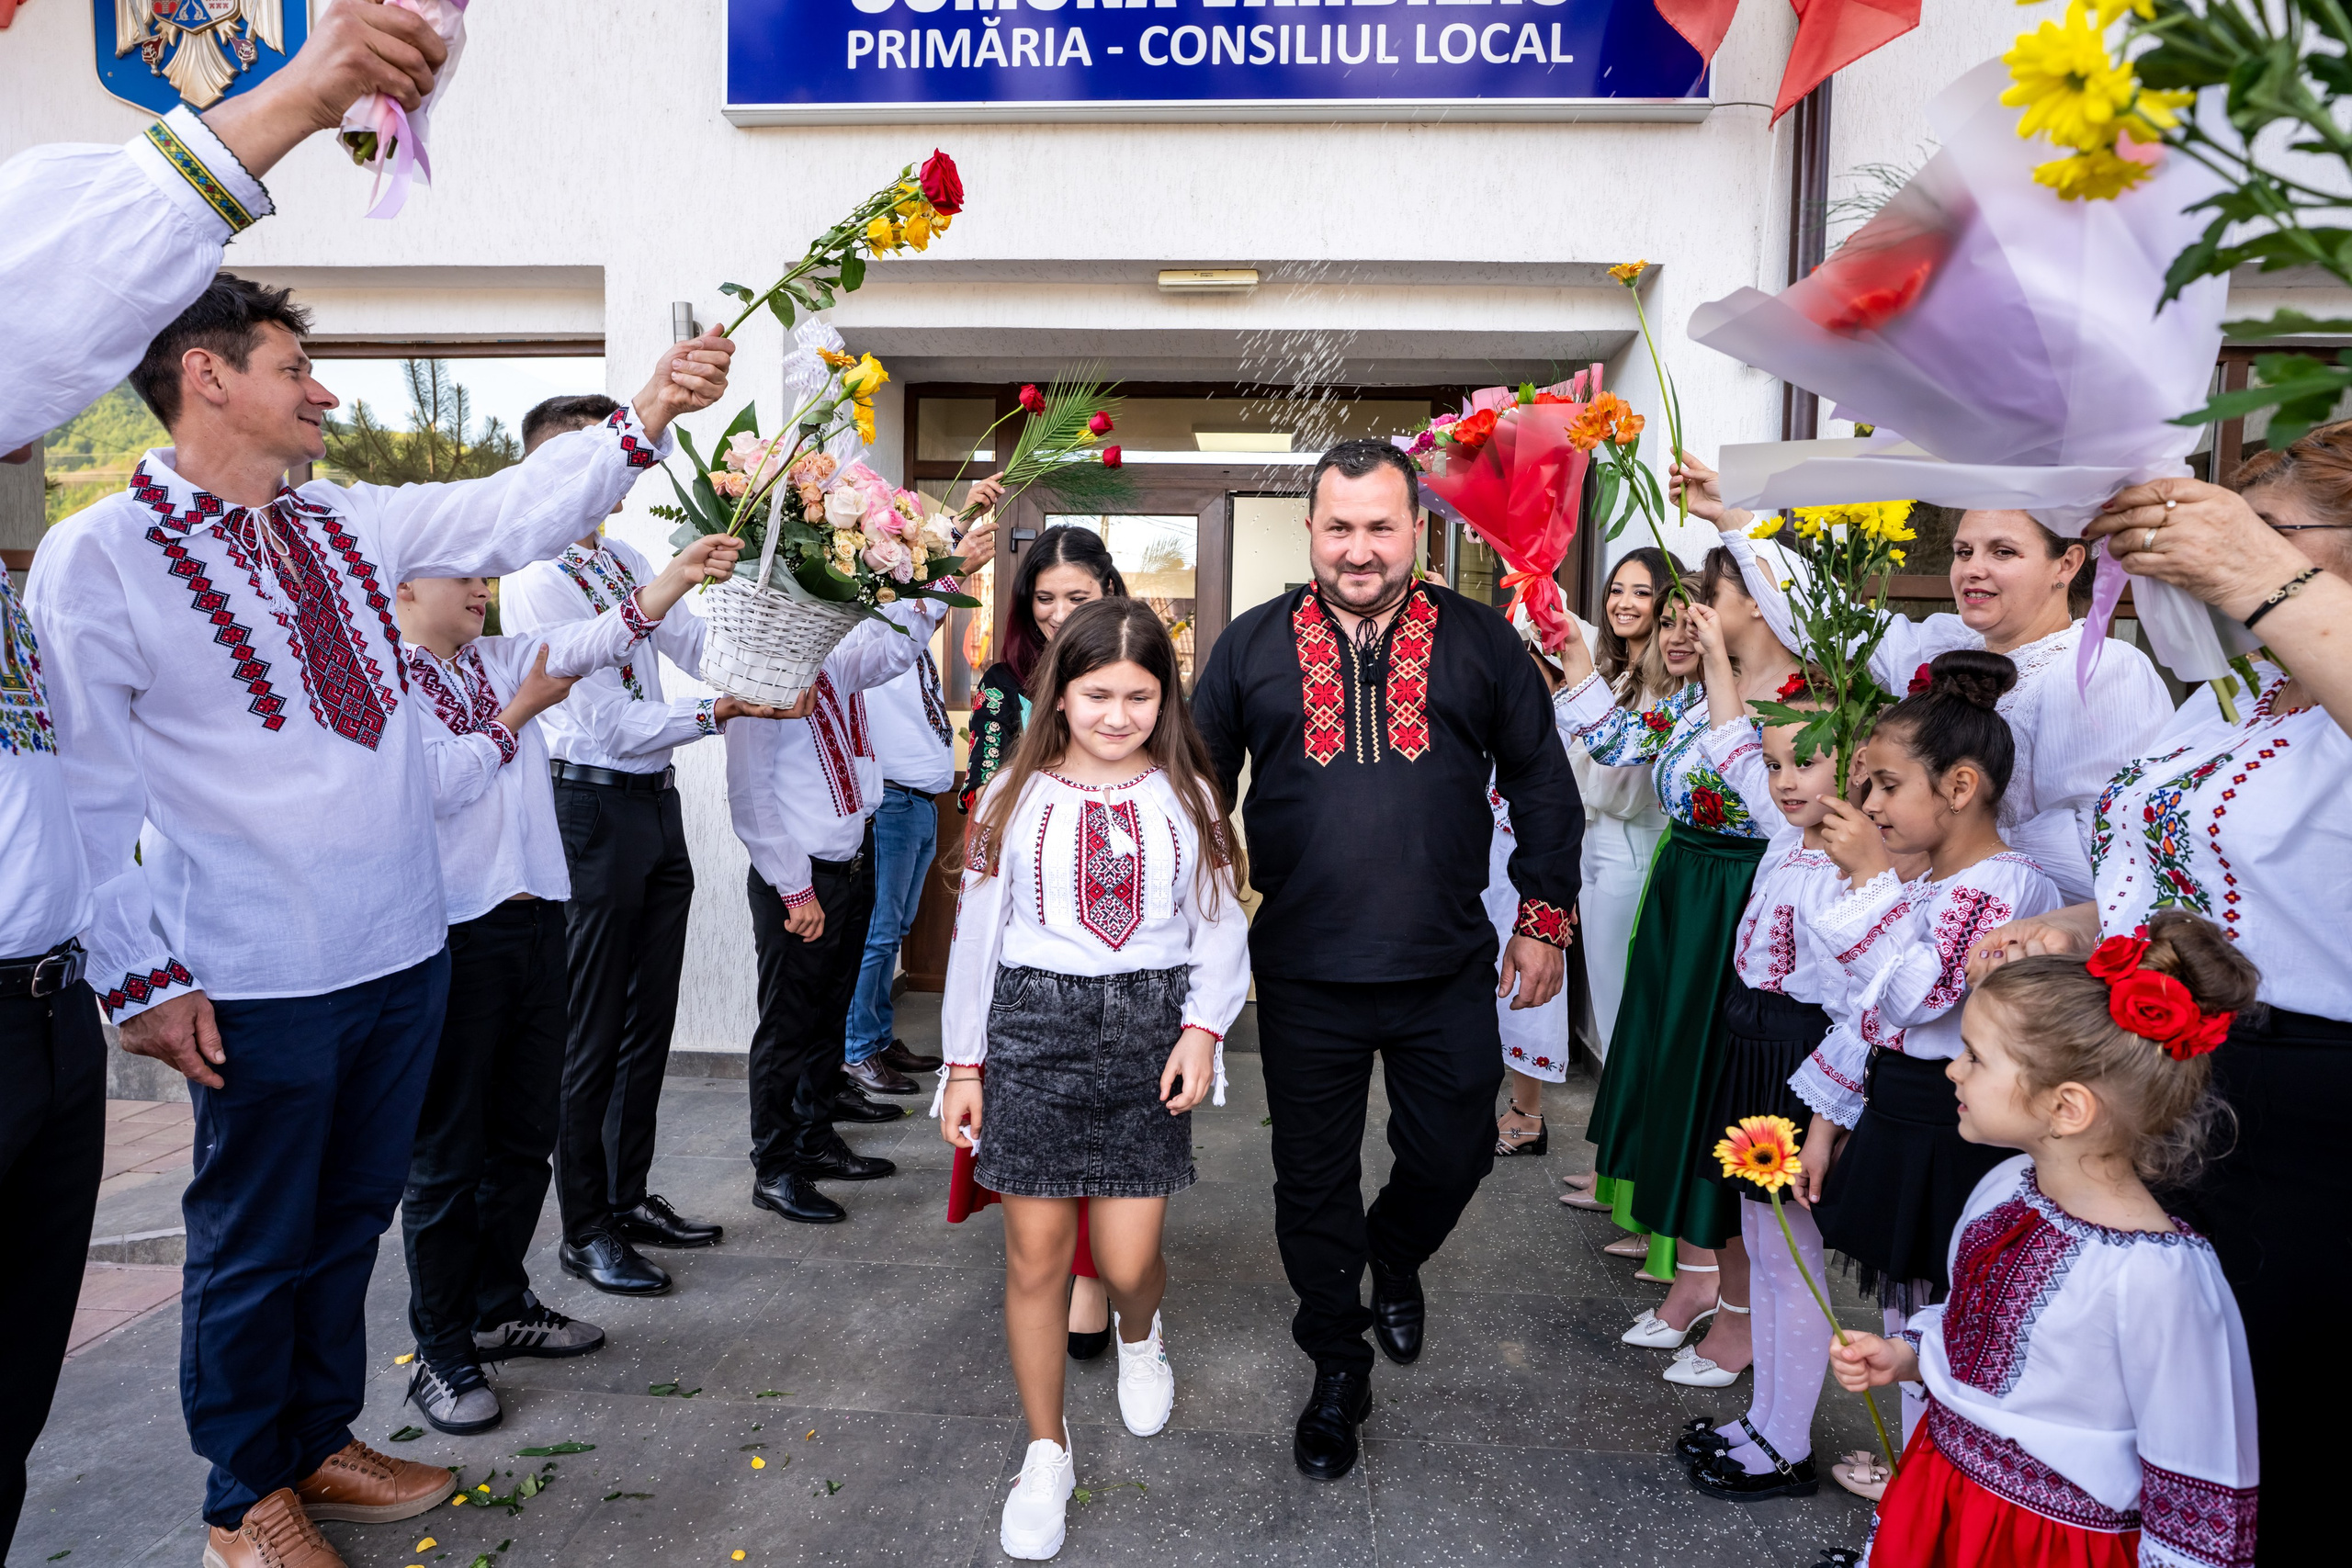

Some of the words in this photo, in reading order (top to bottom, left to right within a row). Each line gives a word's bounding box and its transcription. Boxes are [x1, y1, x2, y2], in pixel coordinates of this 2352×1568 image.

[847, 16, 1093, 70] PRIMĂRIA
[1138, 23, 1400, 66] CONSILIUL
[1415, 22, 1574, 64] LOCAL
